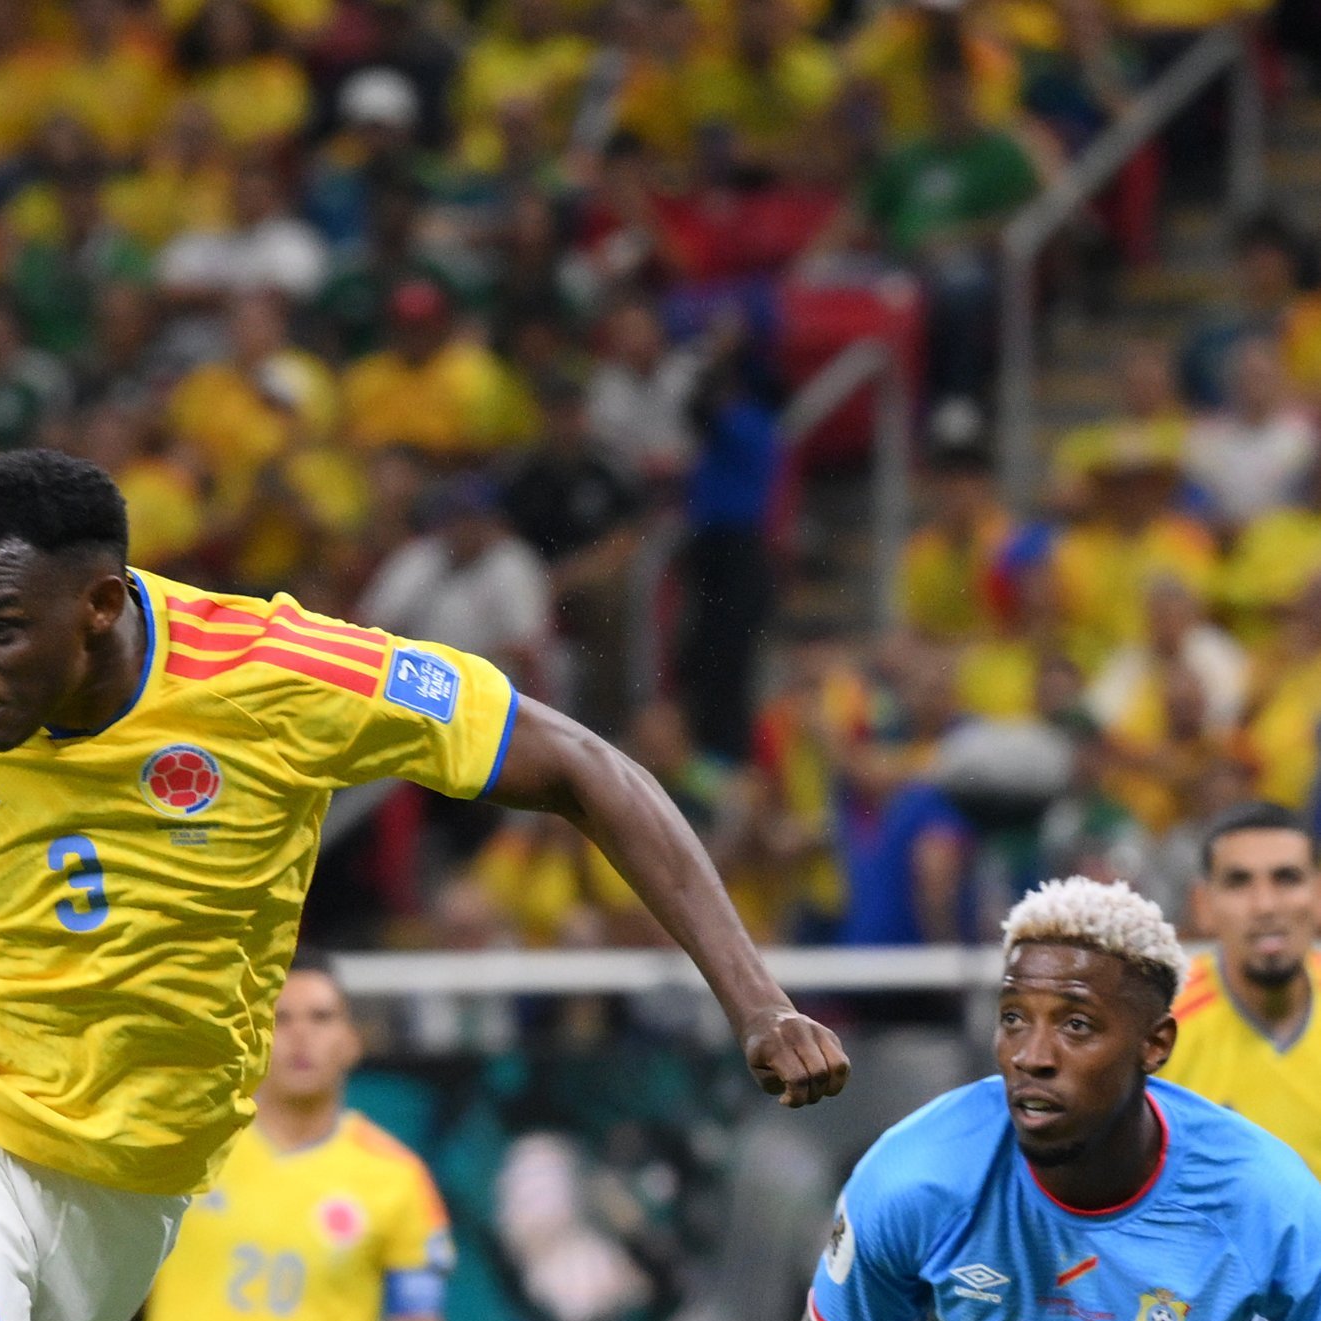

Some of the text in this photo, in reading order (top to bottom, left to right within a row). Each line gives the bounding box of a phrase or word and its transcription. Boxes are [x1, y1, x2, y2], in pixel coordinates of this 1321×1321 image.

[428, 667, 447, 701] PEACE
[48, 834, 109, 932] 3
[227, 1244, 306, 1319] 20
